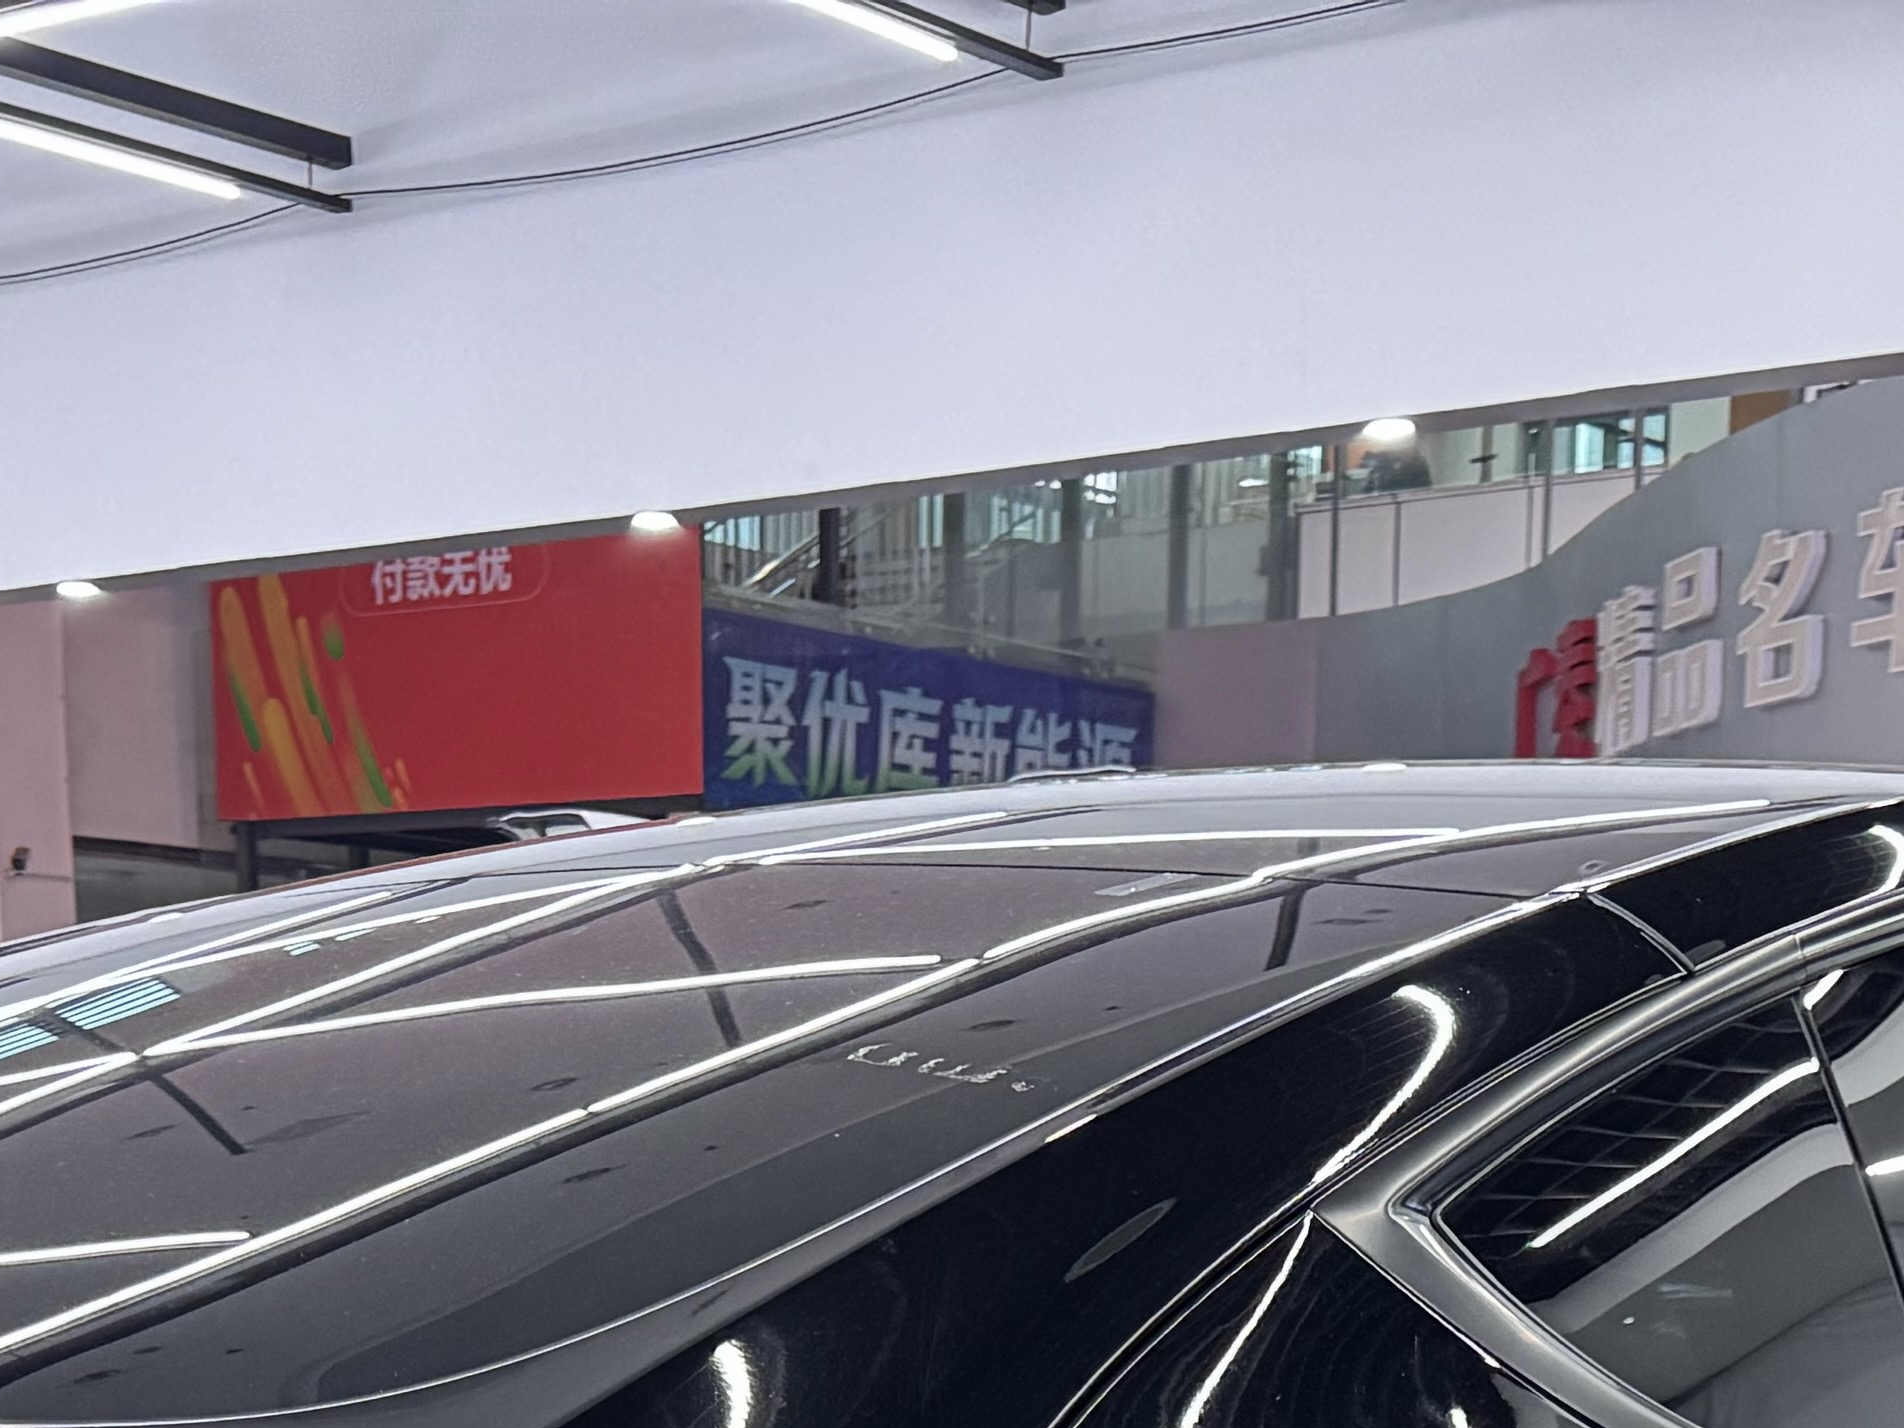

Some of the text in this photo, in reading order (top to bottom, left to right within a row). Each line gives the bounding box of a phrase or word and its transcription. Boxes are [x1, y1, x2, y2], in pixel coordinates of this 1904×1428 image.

[723, 657, 1137, 799] 聚优库新能源
